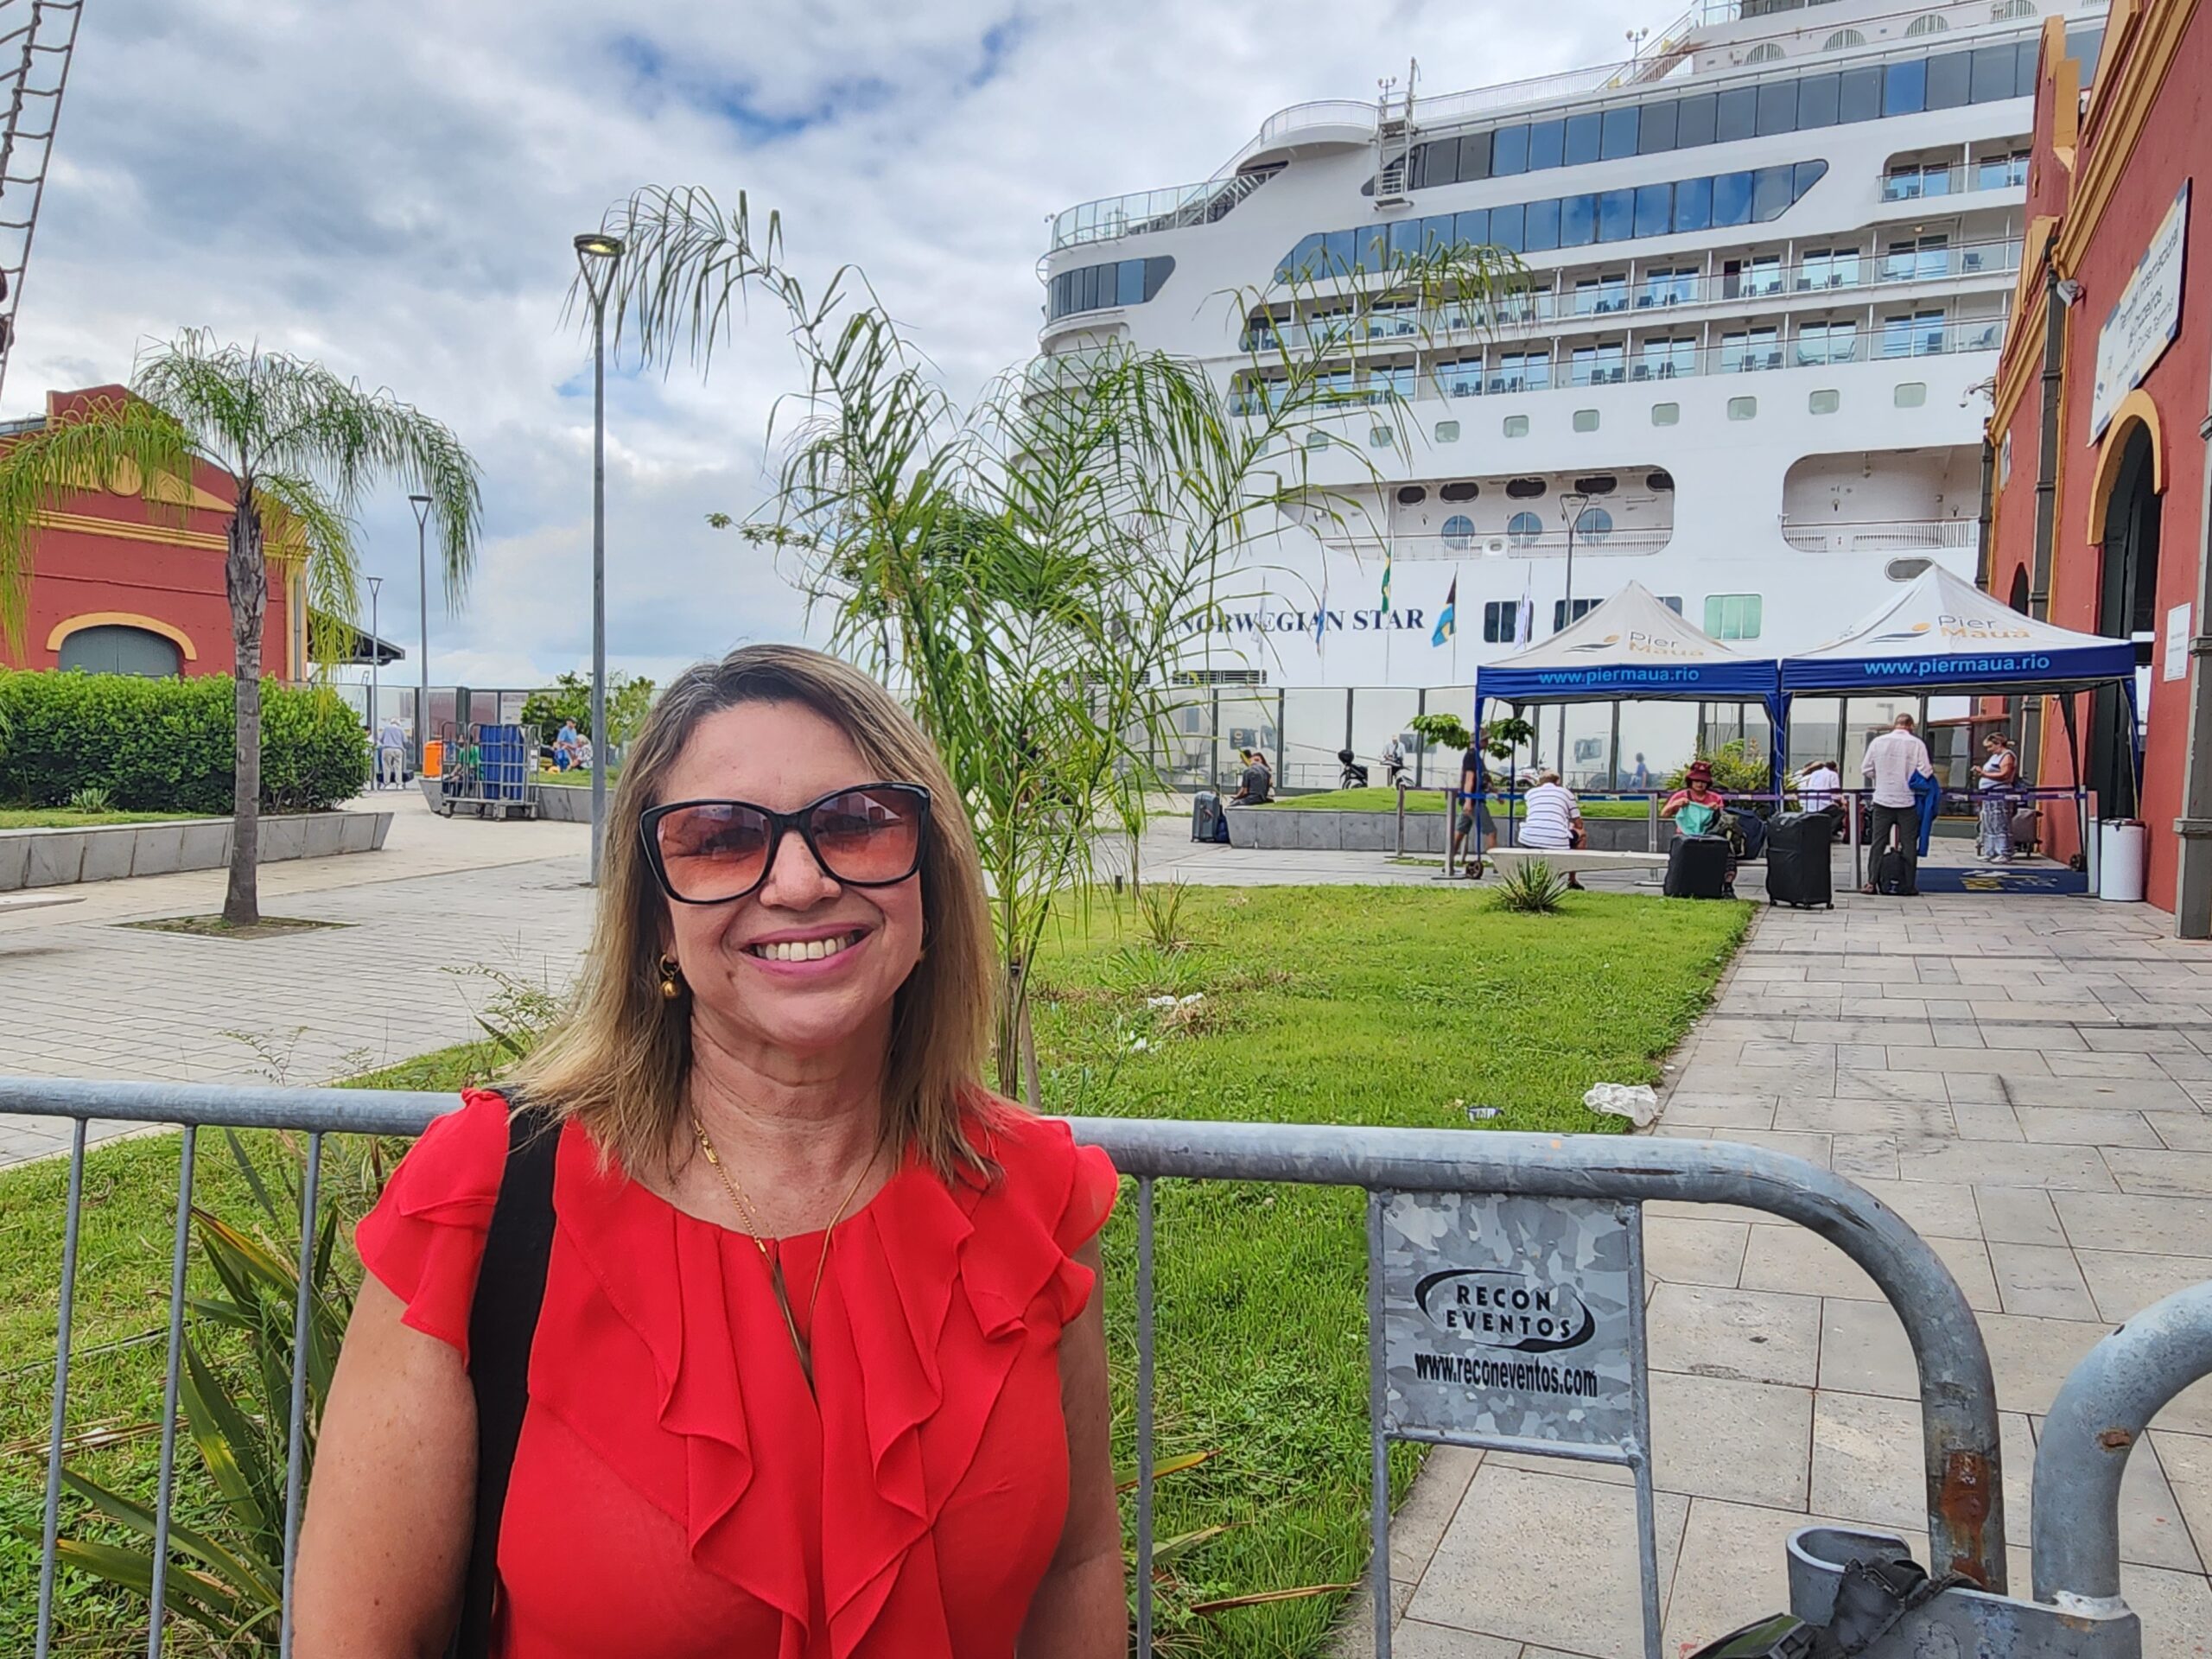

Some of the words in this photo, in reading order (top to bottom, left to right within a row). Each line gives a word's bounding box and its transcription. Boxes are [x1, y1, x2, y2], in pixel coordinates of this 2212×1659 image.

[1177, 610, 1345, 634] NORWEGIAN
[1352, 608, 1425, 631] STAR
[1938, 614, 1997, 629] Pier
[1630, 631, 1679, 648] Pier
[1538, 666, 1700, 686] www.piermaua.rio
[1863, 653, 2050, 677] www.piermaua.rio
[1456, 1284, 1552, 1313] RECON
[1446, 1309, 1572, 1339] EVENTOS
[1414, 1352, 1599, 1398] www.reconeventos.com
